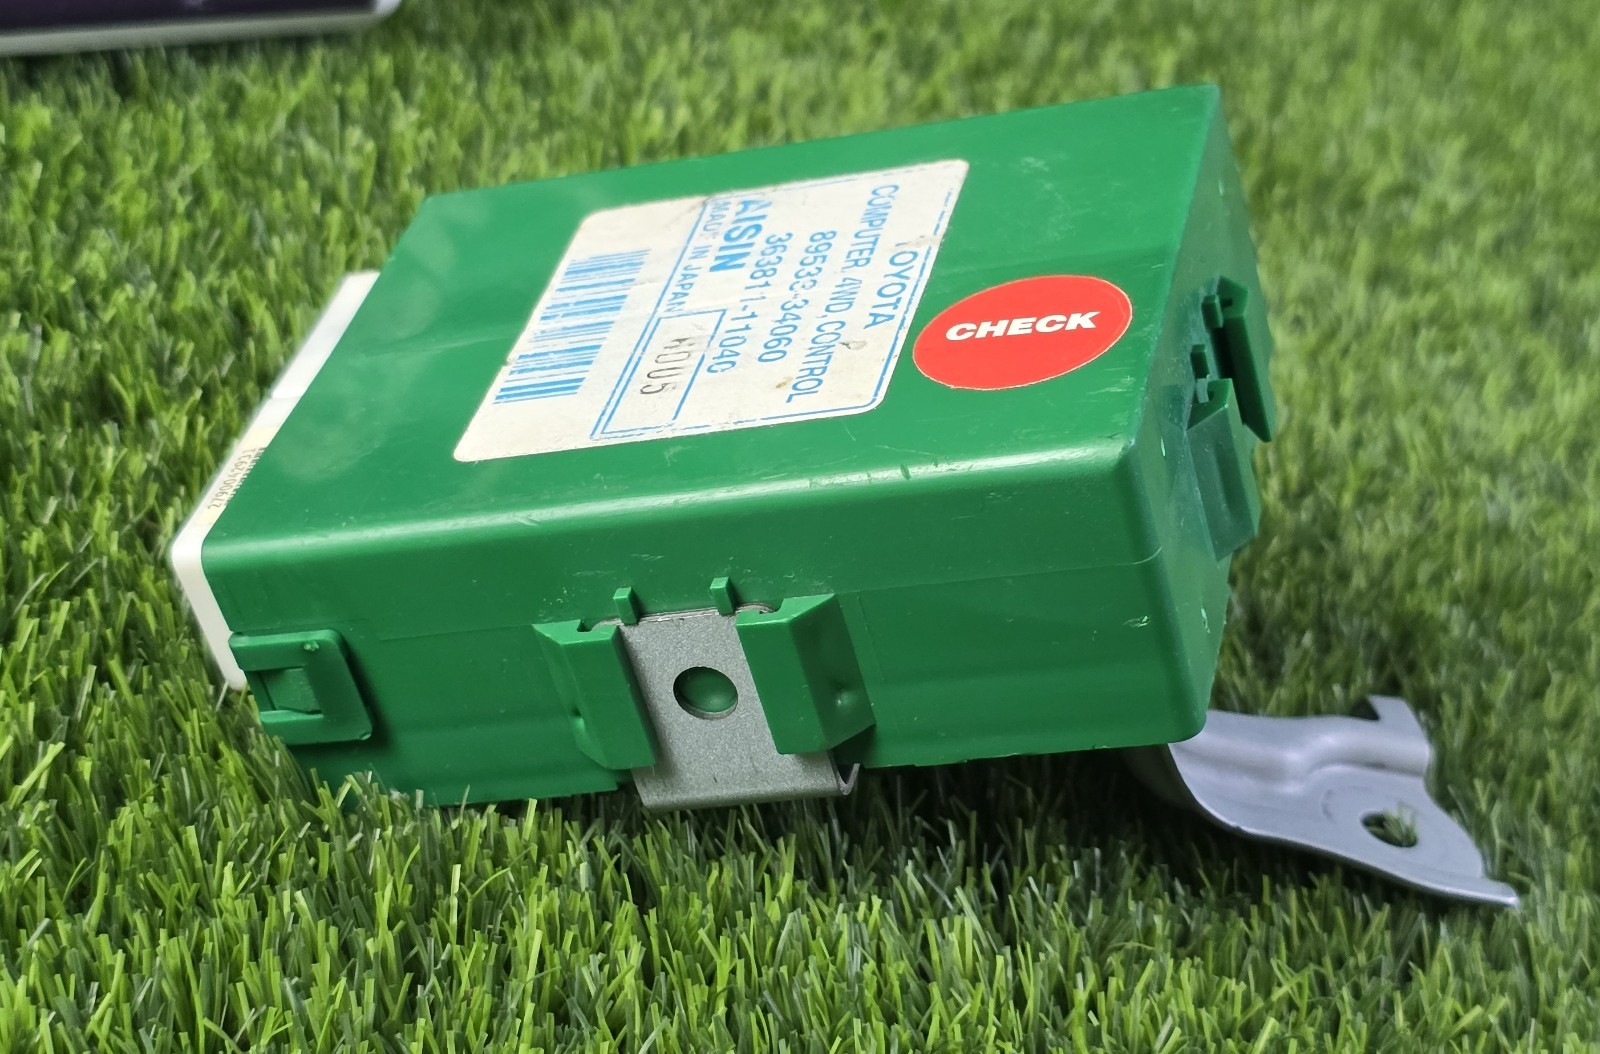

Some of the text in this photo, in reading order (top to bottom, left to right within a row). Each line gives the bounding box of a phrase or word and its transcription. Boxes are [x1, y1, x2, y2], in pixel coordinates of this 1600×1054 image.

[664, 200, 732, 312] MAD IN JAPAN
[709, 200, 773, 273] AISIN
[786, 320, 847, 404] CONTROL
[945, 311, 1101, 341] CHECK
